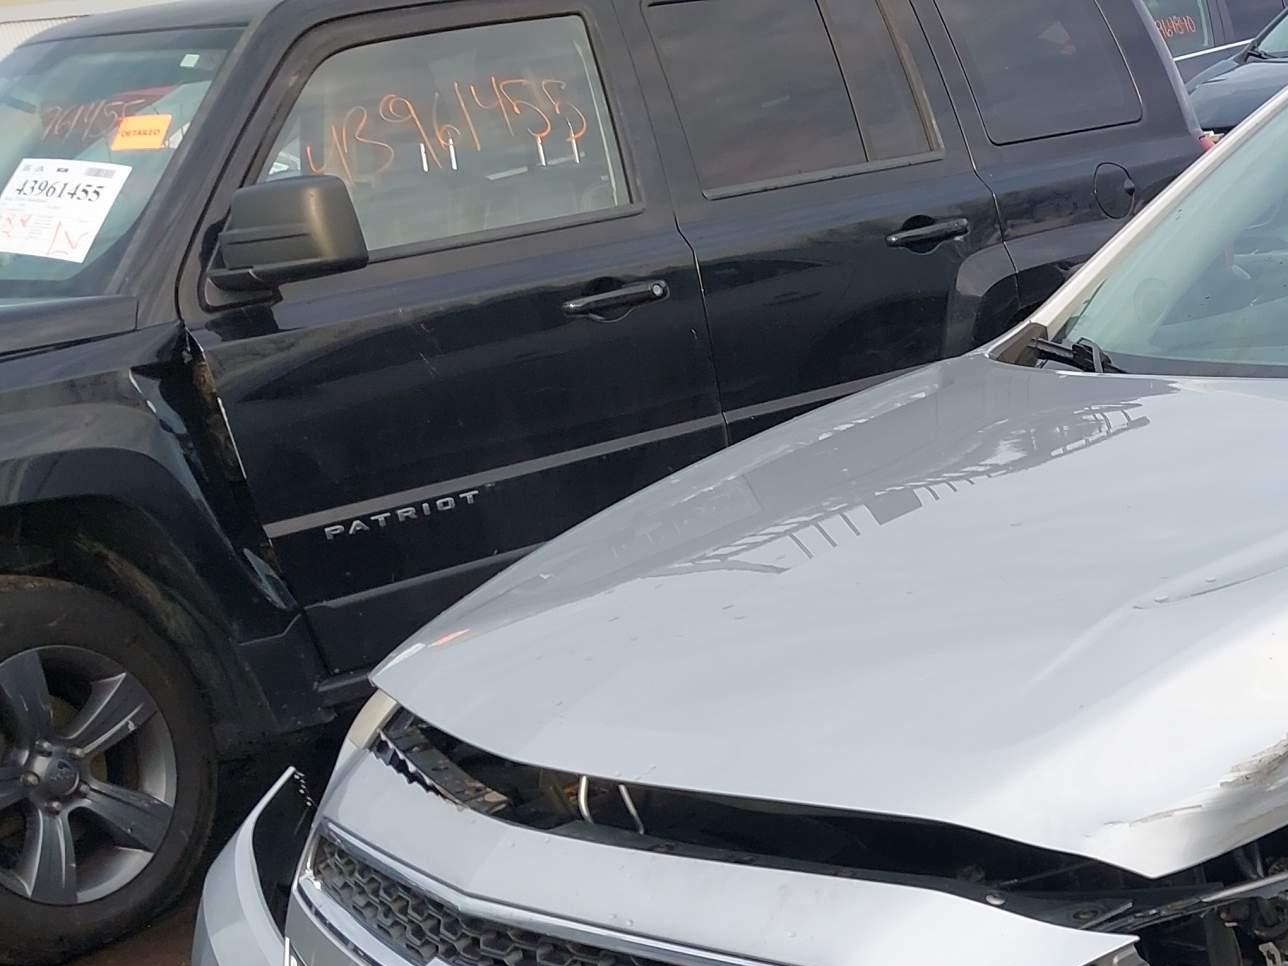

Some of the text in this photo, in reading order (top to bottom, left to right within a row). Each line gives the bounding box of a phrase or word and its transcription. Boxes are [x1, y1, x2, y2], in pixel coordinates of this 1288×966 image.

[306, 76, 588, 184] 43961455
[16, 178, 104, 202] 43961455
[324, 490, 479, 540] PATRIOT
